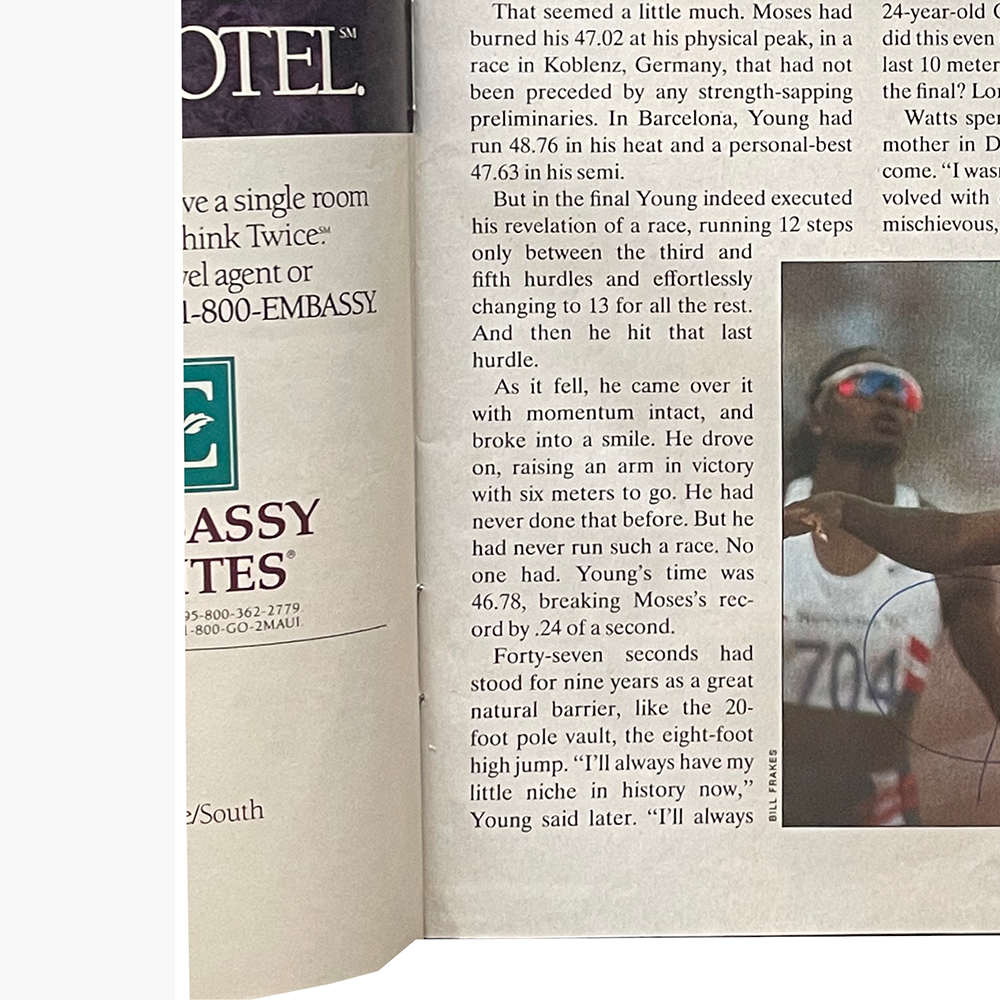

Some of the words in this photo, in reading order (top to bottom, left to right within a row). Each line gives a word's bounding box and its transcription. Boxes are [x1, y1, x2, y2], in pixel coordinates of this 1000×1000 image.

[882, 3, 985, 24] 24-year-old
[471, 61, 509, 73] race
[519, 56, 534, 72] in
[544, 56, 626, 75] Koblenz,
[635, 56, 727, 77] Germany,
[736, 56, 771, 72] that
[781, 56, 813, 72] had
[823, 59, 852, 72] not
[471, 110, 597, 132] preliminaries.
[609, 110, 628, 126] In
[638, 110, 737, 129] Barcelona,
[748, 110, 809, 130] Young
[820, 109, 852, 125] had
[883, 136, 950, 152] mother
[959, 135, 975, 151] in
[214, 194, 228, 213] a
[234, 184, 305, 218] single
[313, 190, 369, 208] room
[472, 217, 497, 234] his
[505, 217, 596, 233] revelation
[605, 217, 624, 233] of
[631, 222, 640, 233] a
[648, 221, 691, 236] race,
[700, 216, 772, 237] running
[780, 216, 800, 232] 12
[807, 218, 853, 237] steps
[883, 215, 998, 235] mischievous,
[214, 263, 281, 293] agent
[287, 264, 313, 283] or
[473, 271, 510, 287] fifth
[525, 270, 593, 287] hurdles
[606, 270, 639, 286] and
[654, 270, 752, 291] effortlessly
[472, 593, 526, 613] 46.78,
[540, 592, 620, 613] breaking
[634, 591, 706, 608] Moses's
[720, 595, 754, 607] rec-
[493, 648, 602, 668] Forty-seven
[626, 645, 698, 662] seconds
[721, 645, 753, 661] had
[471, 729, 508, 746] foot
[517, 728, 557, 751] pole
[566, 727, 616, 747] vault,
[626, 726, 654, 743] the
[663, 725, 753, 747] eight-foot
[768, 749, 778, 793] FRAKES
[768, 798, 778, 822] BILL
